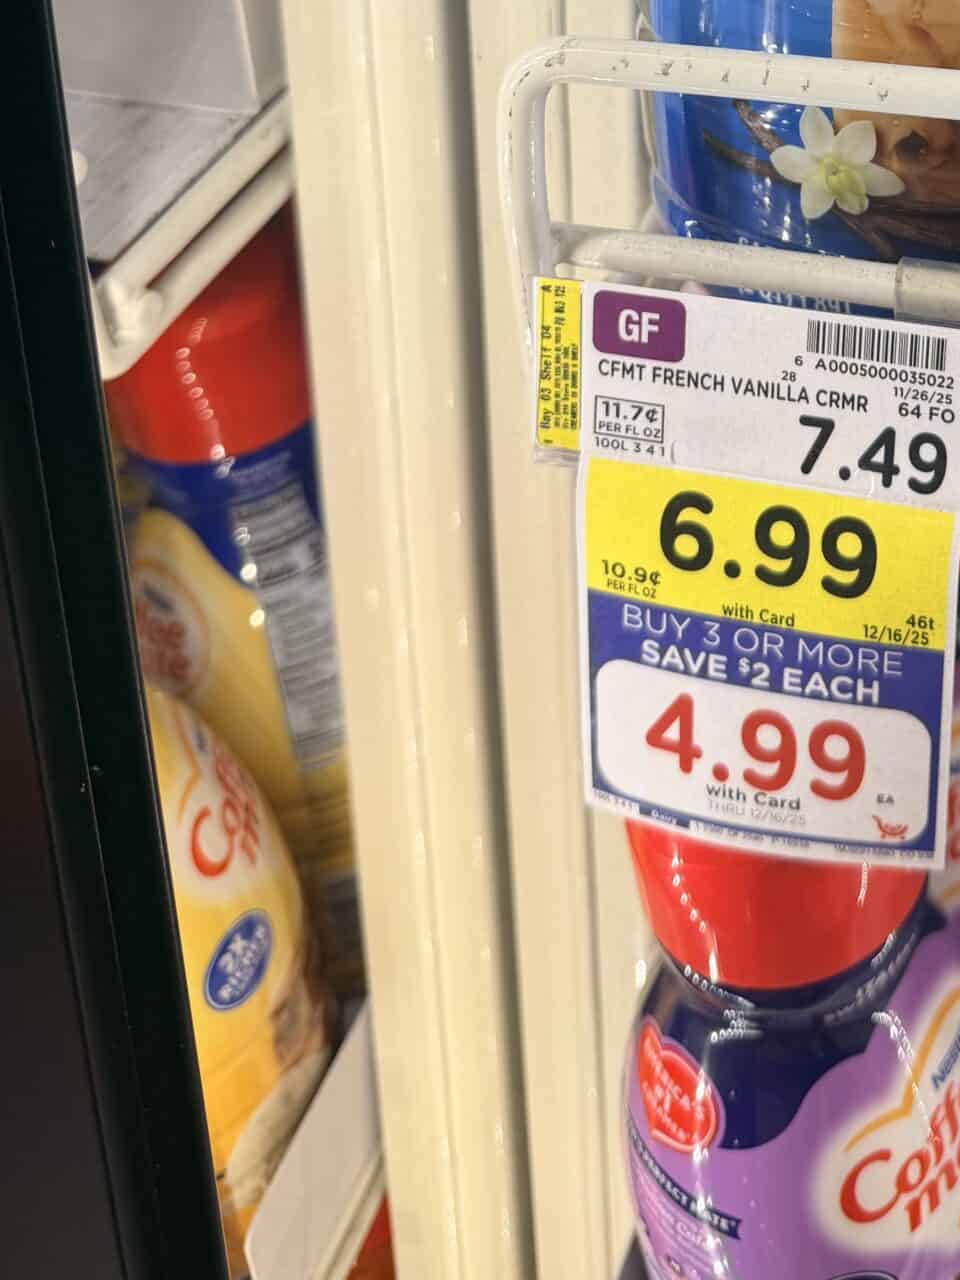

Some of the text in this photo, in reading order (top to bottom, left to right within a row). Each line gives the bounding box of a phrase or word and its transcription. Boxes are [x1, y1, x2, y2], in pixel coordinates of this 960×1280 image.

[617, 309, 660, 345] GF
[598, 358, 869, 414] CFMT FRENCH VANILLA CRMR
[781, 370, 797, 382] 28
[794, 355, 955, 390] 6 A0005000035022
[894, 386, 953, 405] 11/26/25
[898, 402, 956, 424] 64 FO
[598, 420, 661, 439] PER FL OZ
[633, 442, 641, 453] 3
[646, 445, 655, 456] 4
[799, 415, 948, 496] 7.49
[659, 490, 878, 599] 6.99
[601, 558, 662, 587] 10.9¢
[606, 578, 658, 600] PER FL OZ
[721, 601, 796, 628] with Card
[622, 601, 905, 678] BUY 3 OR MORE
[862, 623, 930, 648] 12/16/25
[640, 639, 881, 705] SAVE $2 EACH
[645, 691, 867, 802] 4.99
[705, 781, 801, 811] with Card
[876, 793, 896, 806] EA
